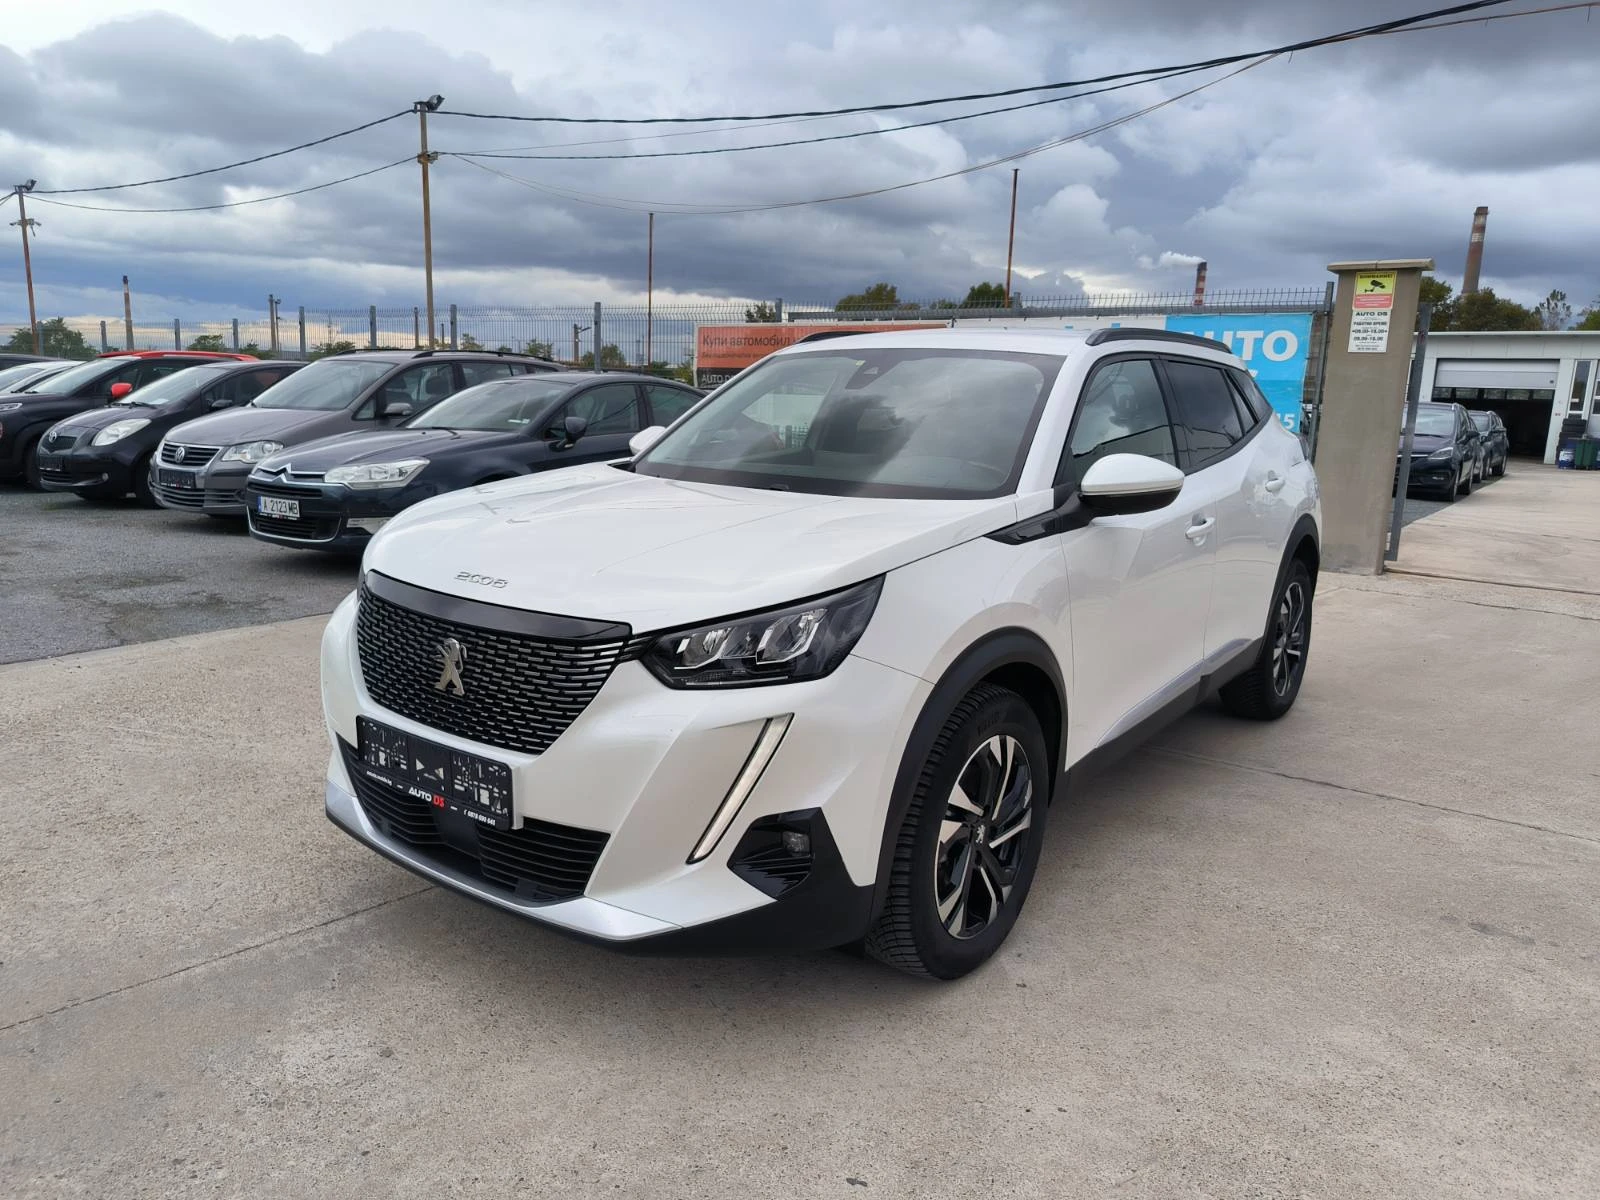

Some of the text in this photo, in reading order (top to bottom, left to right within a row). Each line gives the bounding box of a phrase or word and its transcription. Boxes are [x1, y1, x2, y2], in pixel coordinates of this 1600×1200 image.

[703, 333, 791, 348] Купи автомобил
[1180, 330, 1298, 362] TO
[701, 374, 724, 384] AUTO
[263, 498, 268, 512] A
[270, 499, 288, 513] 2123
[454, 570, 508, 589] 2008
[408, 786, 432, 802] AUTO
